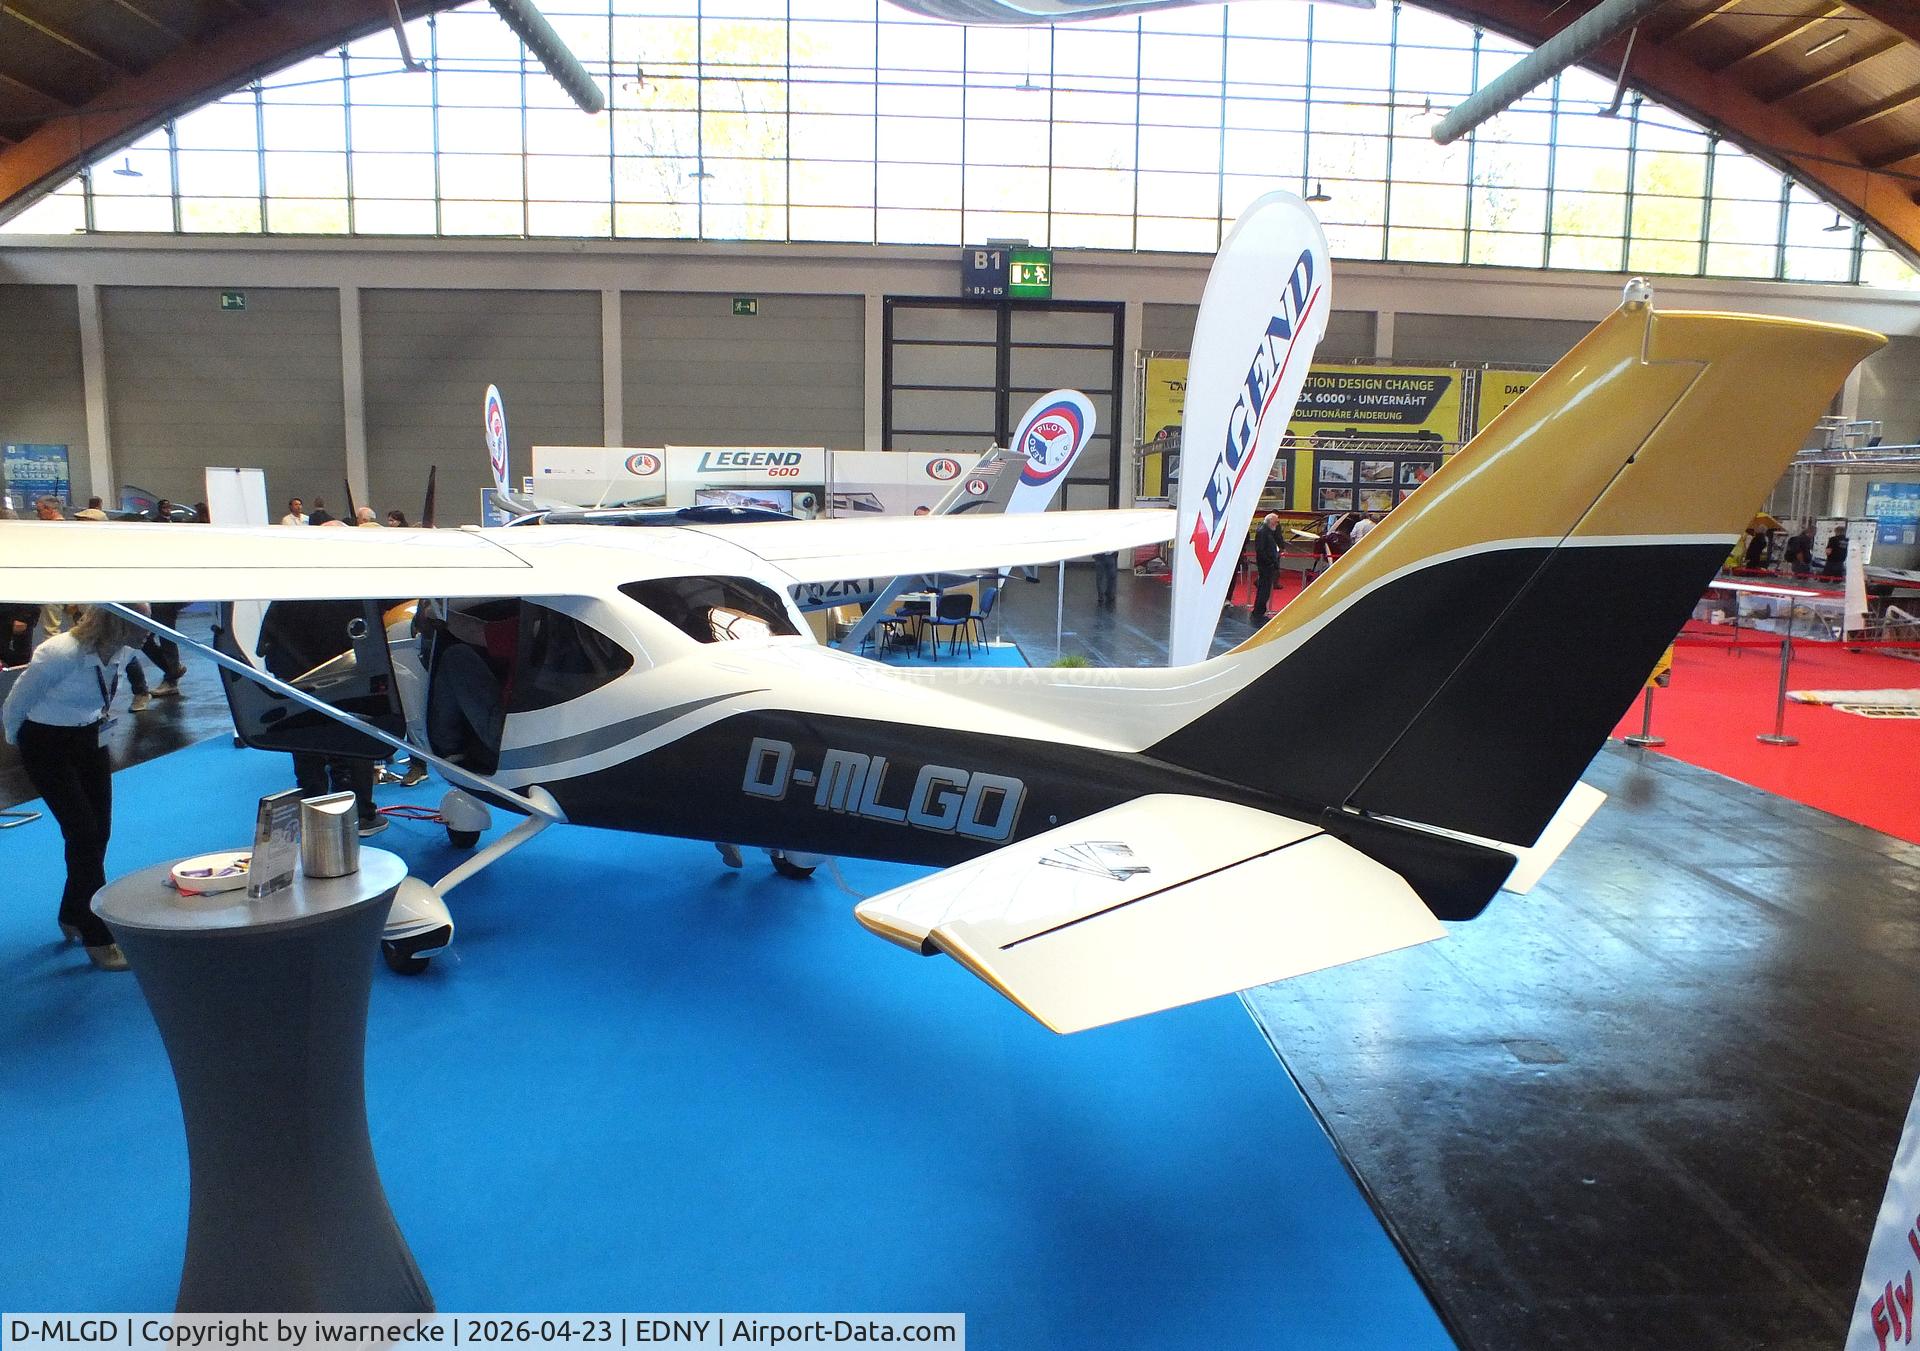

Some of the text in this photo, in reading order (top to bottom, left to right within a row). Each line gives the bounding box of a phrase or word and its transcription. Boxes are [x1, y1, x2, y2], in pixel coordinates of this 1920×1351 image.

[975, 251, 1000, 270] B1
[1338, 378, 1382, 390] DESIGN
[1385, 380, 1435, 391] CHANGE
[1358, 394, 1427, 406] UNVERNÄHT
[1190, 249, 1322, 584] LEGEND
[1293, 409, 1402, 420] OLUTIONÄRE ÄNDERUNG
[1037, 423, 1064, 434] PILOT
[1029, 438, 1045, 462] AERO
[697, 452, 802, 473] LEGEND
[768, 468, 800, 477] 600
[742, 737, 1028, 845] D-MLGD
